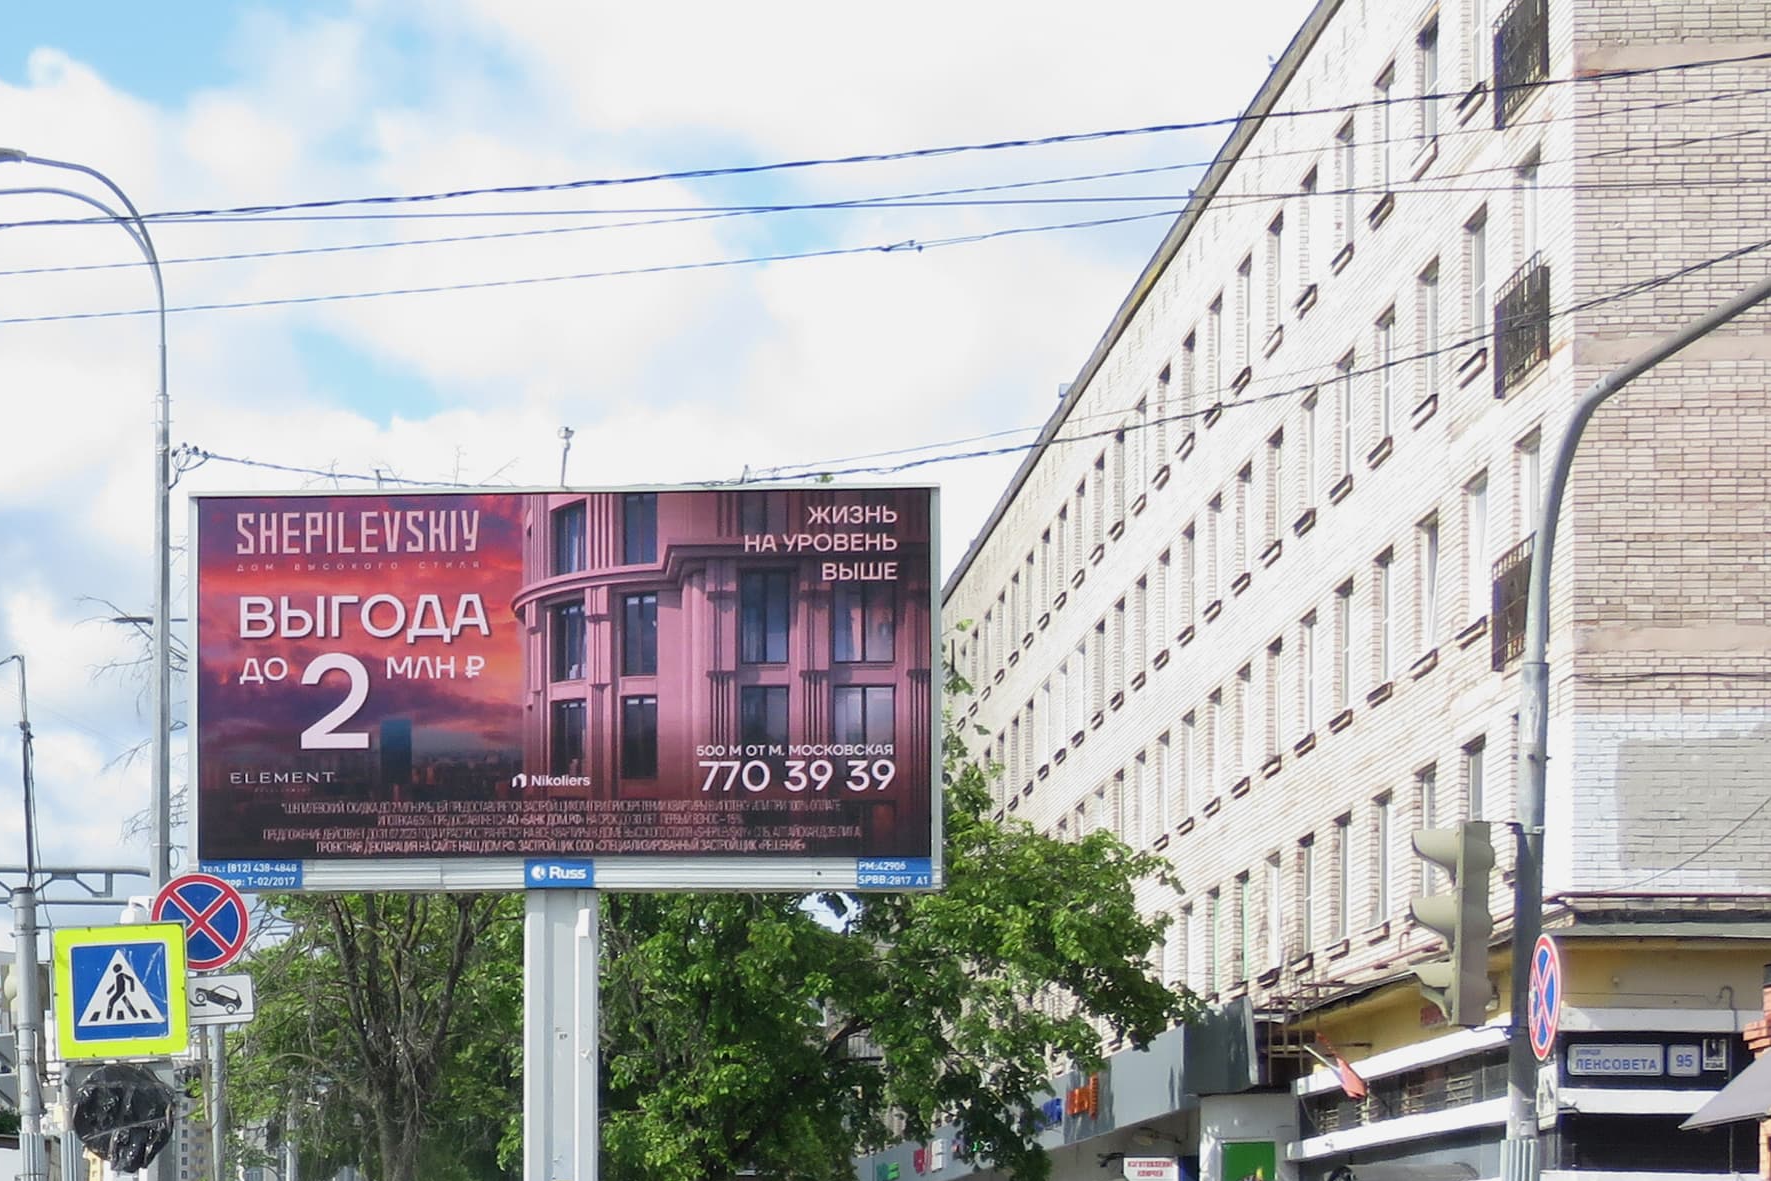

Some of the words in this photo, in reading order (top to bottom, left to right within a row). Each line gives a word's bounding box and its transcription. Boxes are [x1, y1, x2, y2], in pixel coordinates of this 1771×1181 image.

[807, 505, 898, 524] ЖИЗНЬ
[236, 510, 479, 555] SHEPILEVSKIY
[744, 534, 777, 552] НА
[782, 533, 898, 552] УРОВЕНЬ
[236, 563, 275, 572] ДОМ
[293, 561, 399, 571] ВЫСОКОГО
[822, 562, 898, 580] ВЫШЕ
[239, 593, 491, 644] ВЫГОДА
[239, 657, 288, 685] ДО
[300, 652, 370, 750] 2
[386, 656, 456, 679] МЛН
[696, 744, 726, 757] 500
[729, 744, 742, 757] М
[746, 744, 765, 757] ОТ
[768, 744, 785, 757] М.
[788, 743, 894, 757] МОСКОВСКАЯ
[229, 771, 335, 784] ELEMENT
[531, 774, 591, 787] Nikoliers
[698, 760, 771, 792] 770
[784, 759, 833, 791] 39
[845, 759, 896, 791] 39
[228, 863, 251, 873] (812)
[549, 866, 587, 879] Russ
[248, 877, 295, 887] Т-02/2017
[1576, 1058, 1658, 1071] ЛЕНСОВЕТА
[1675, 1054, 1693, 1068] 95
